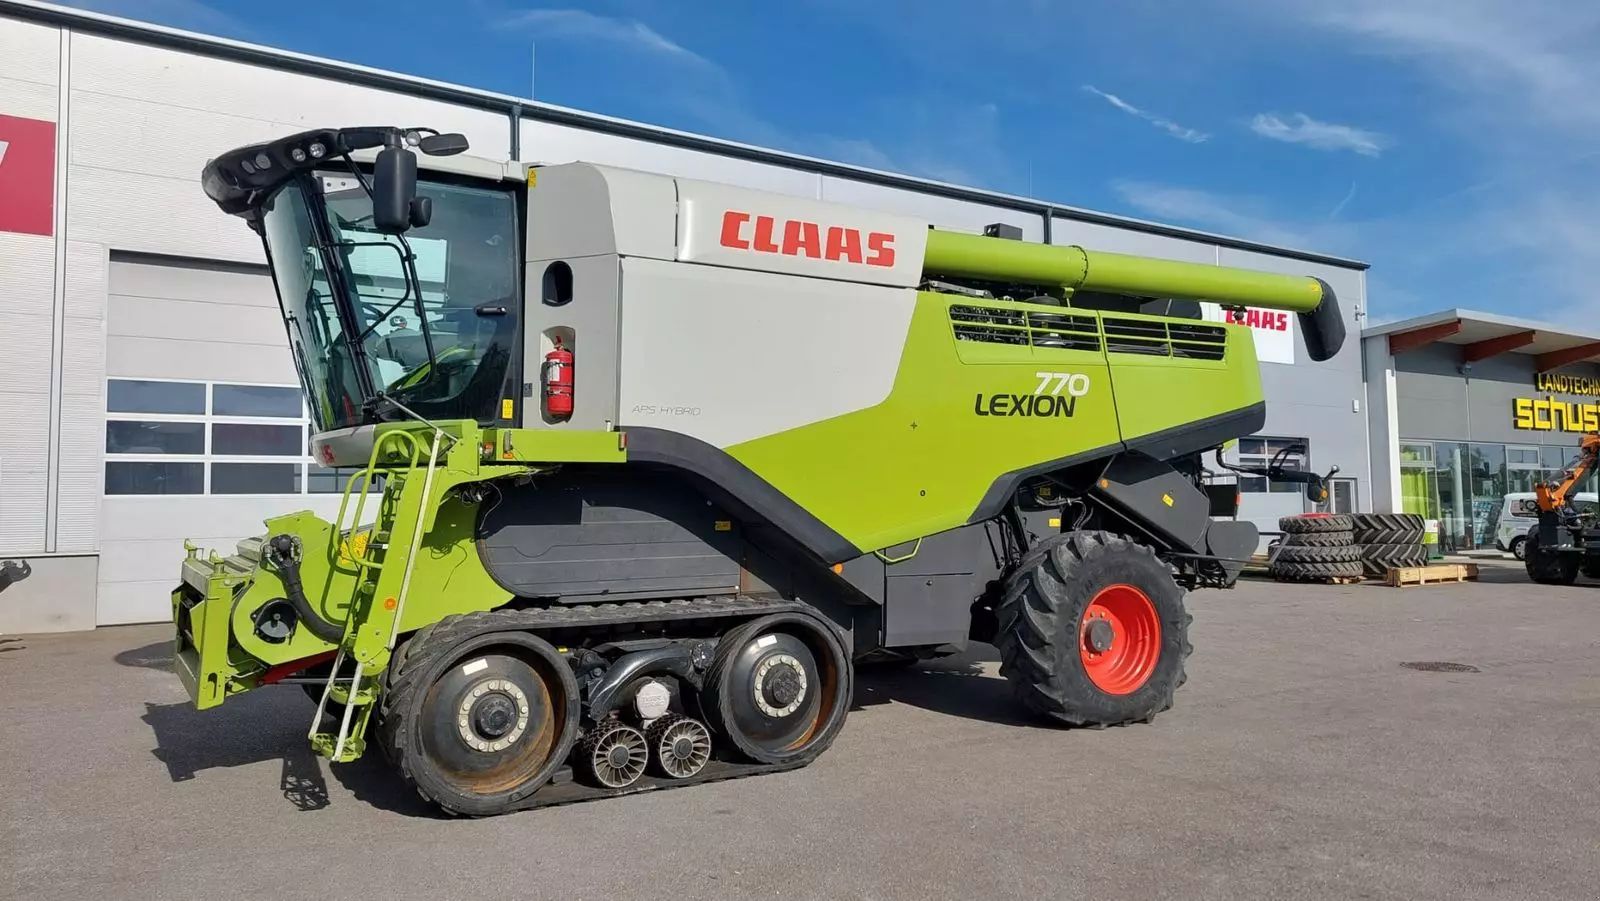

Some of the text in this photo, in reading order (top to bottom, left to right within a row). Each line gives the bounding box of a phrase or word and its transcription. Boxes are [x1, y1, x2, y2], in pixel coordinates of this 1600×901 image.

[720, 211, 895, 267] CLAAS
[1034, 371, 1090, 396] 770
[632, 405, 701, 416] APS HYBRID
[975, 393, 1076, 417] LEXION
